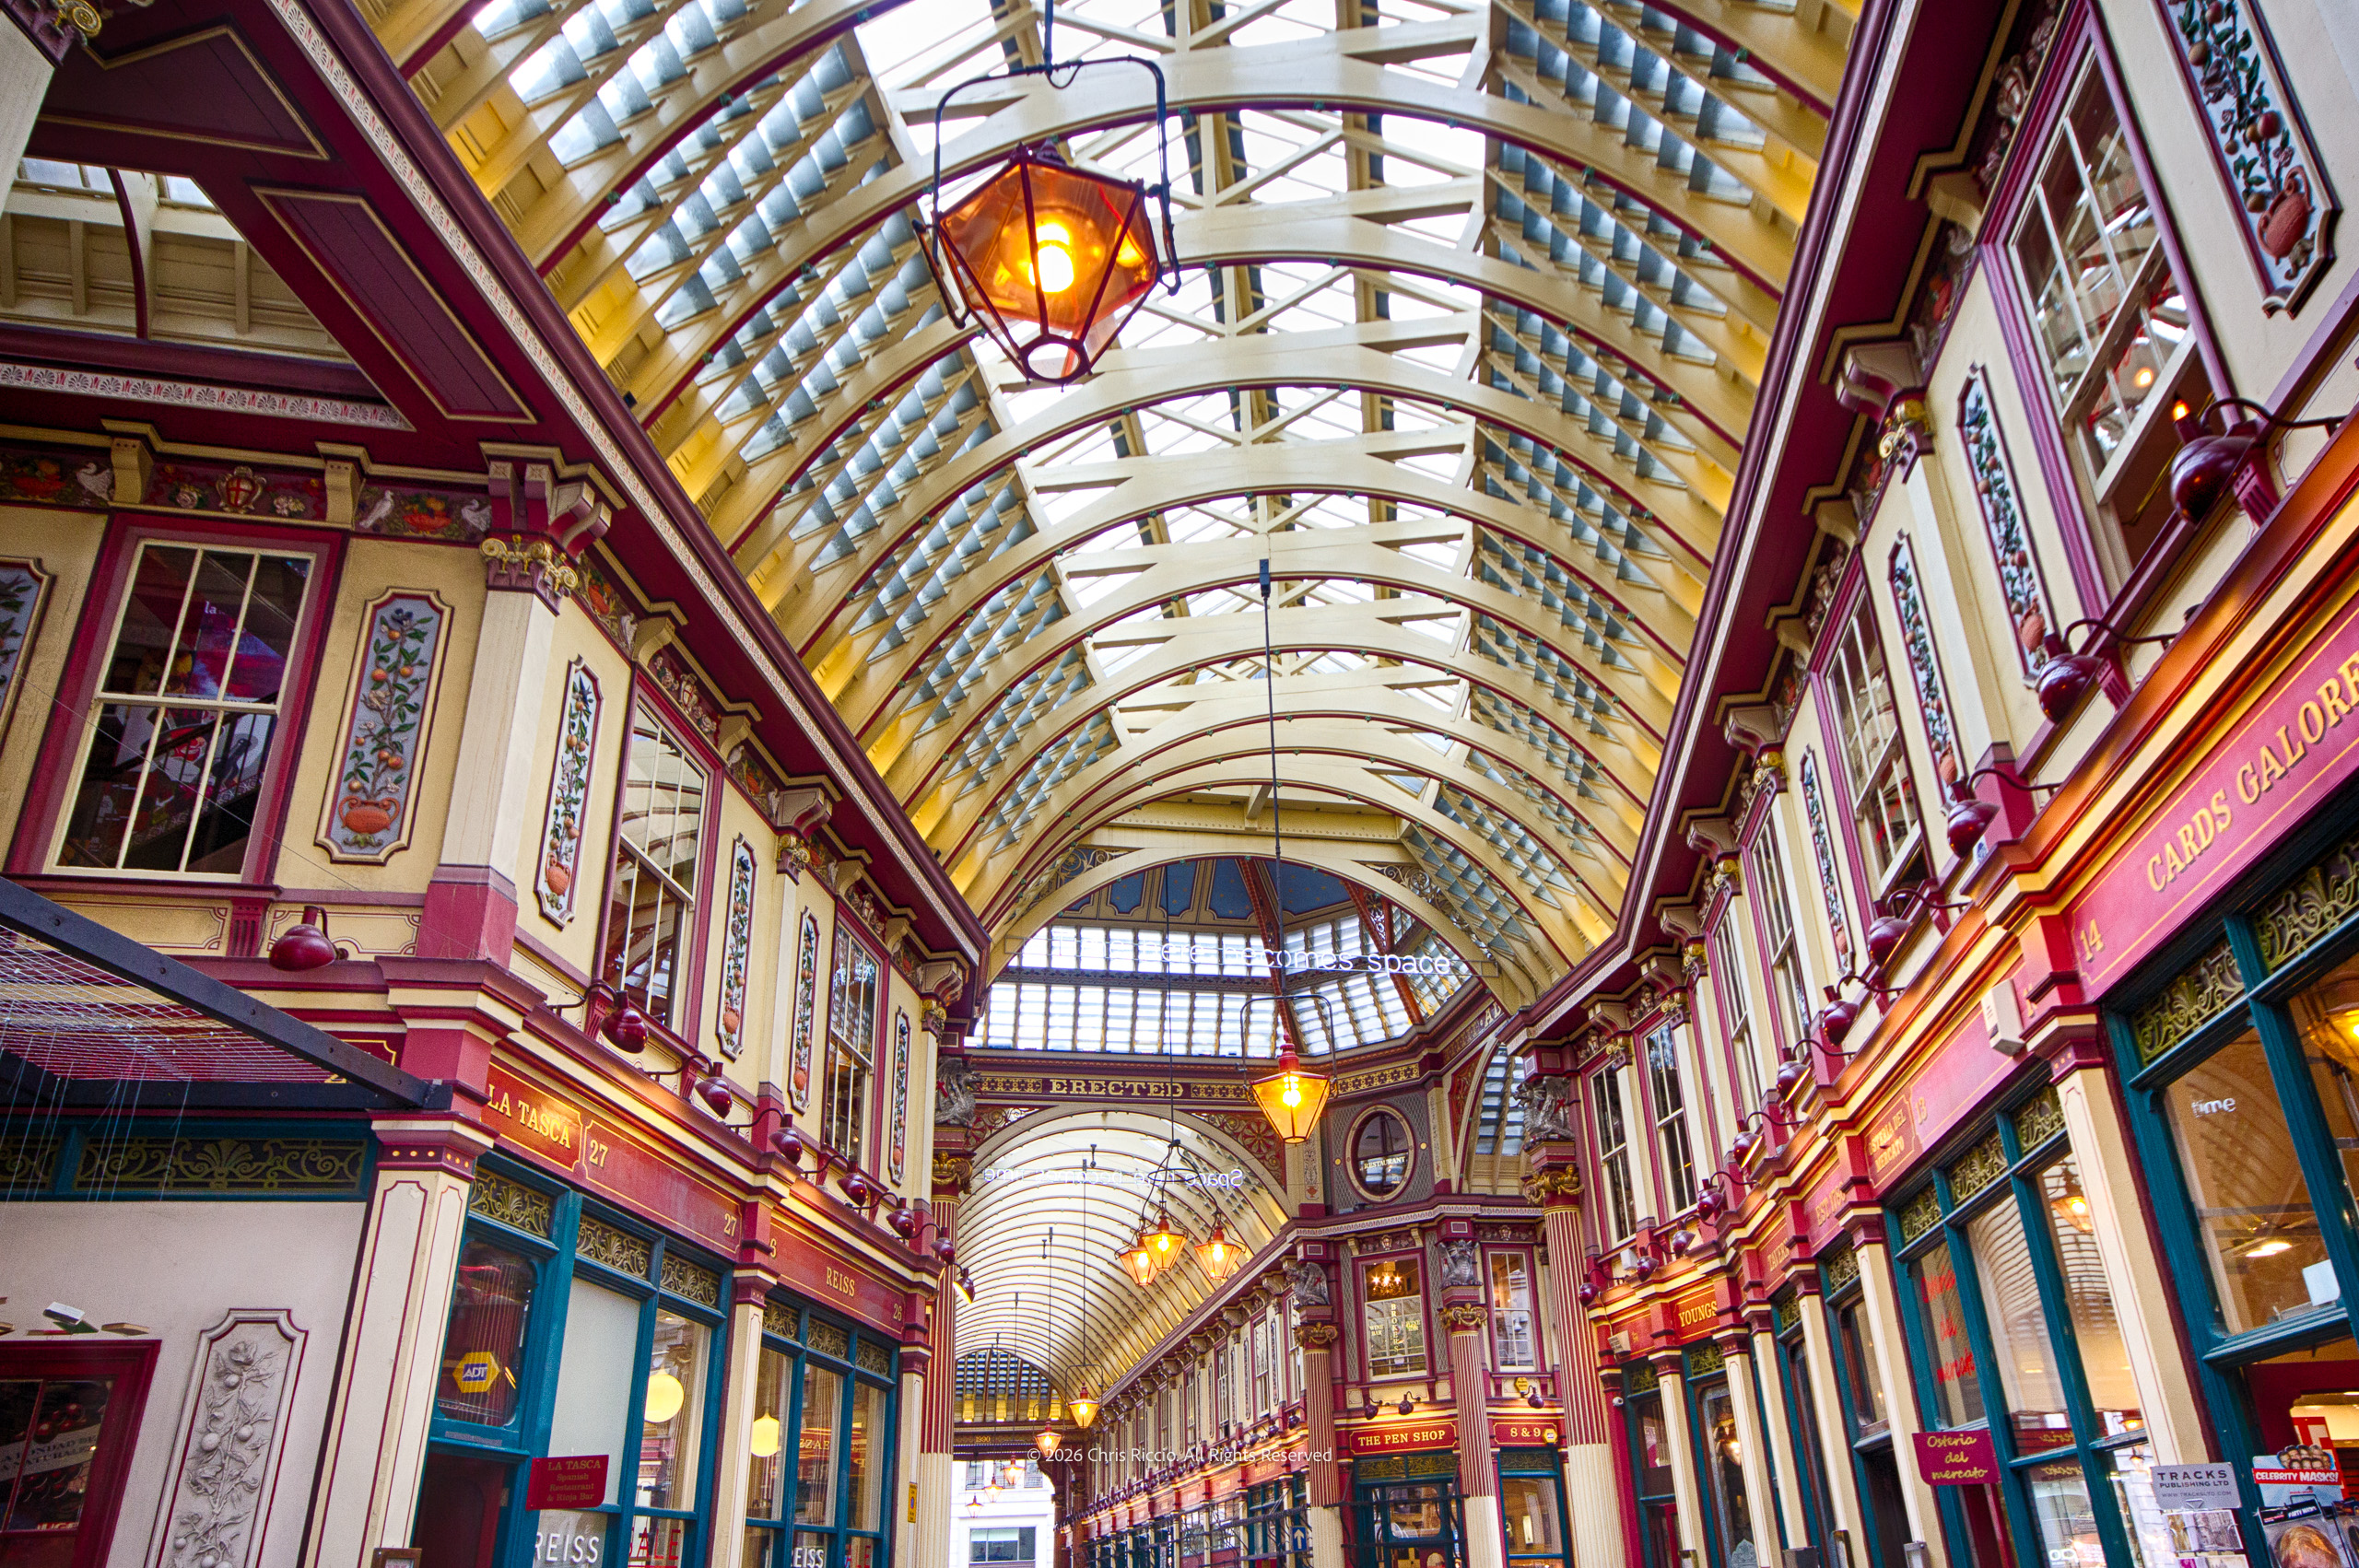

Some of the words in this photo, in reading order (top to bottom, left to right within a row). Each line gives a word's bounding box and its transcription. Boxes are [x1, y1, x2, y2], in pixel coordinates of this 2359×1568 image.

[2146, 789, 2234, 894] CARDS
[2080, 918, 2105, 963] 14
[1143, 938, 1204, 963] here
[1222, 942, 1354, 971] becomes
[1367, 952, 1450, 977] space
[1049, 1078, 1185, 1098] ERECTED
[487, 1082, 512, 1117] LA
[517, 1099, 571, 1150] TASCA
[1916, 1096, 1929, 1125] 13
[589, 1139, 609, 1168] 27
[1363, 1155, 1406, 1170] RESTAURANT
[723, 1212, 737, 1237] 27
[826, 1266, 856, 1298] REISS
[893, 1303, 902, 1322] 26
[1678, 1300, 1719, 1328] YOUNGS
[1391, 1303, 1399, 1352] BROKERS
[463, 1366, 488, 1378] ADT
[1357, 1435, 1381, 1446] THE
[1384, 1433, 1409, 1445] PEN
[1413, 1430, 1446, 1442] SHOP
[1509, 1427, 1519, 1437] 8
[1520, 1427, 1531, 1437] &
[1532, 1427, 1542, 1437] 9
[1926, 1433, 1978, 1448] Osteria
[547, 1461, 563, 1471] LA
[566, 1458, 602, 1470] TASCA
[1944, 1450, 1969, 1464] del
[556, 1472, 589, 1482] Spanish
[1931, 1466, 1989, 1480] mercato
[2157, 1469, 2228, 1481] TRACKS
[2255, 1471, 2298, 1481] CELEBRITY
[2299, 1471, 2339, 1482] MASKS!
[549, 1482, 595, 1492] Restaurant
[2159, 1480, 2211, 1489] PUBLISHING
[556, 1493, 578, 1504] Rioja
[579, 1492, 595, 1502] Bar
[791, 1546, 825, 1568] EISS
